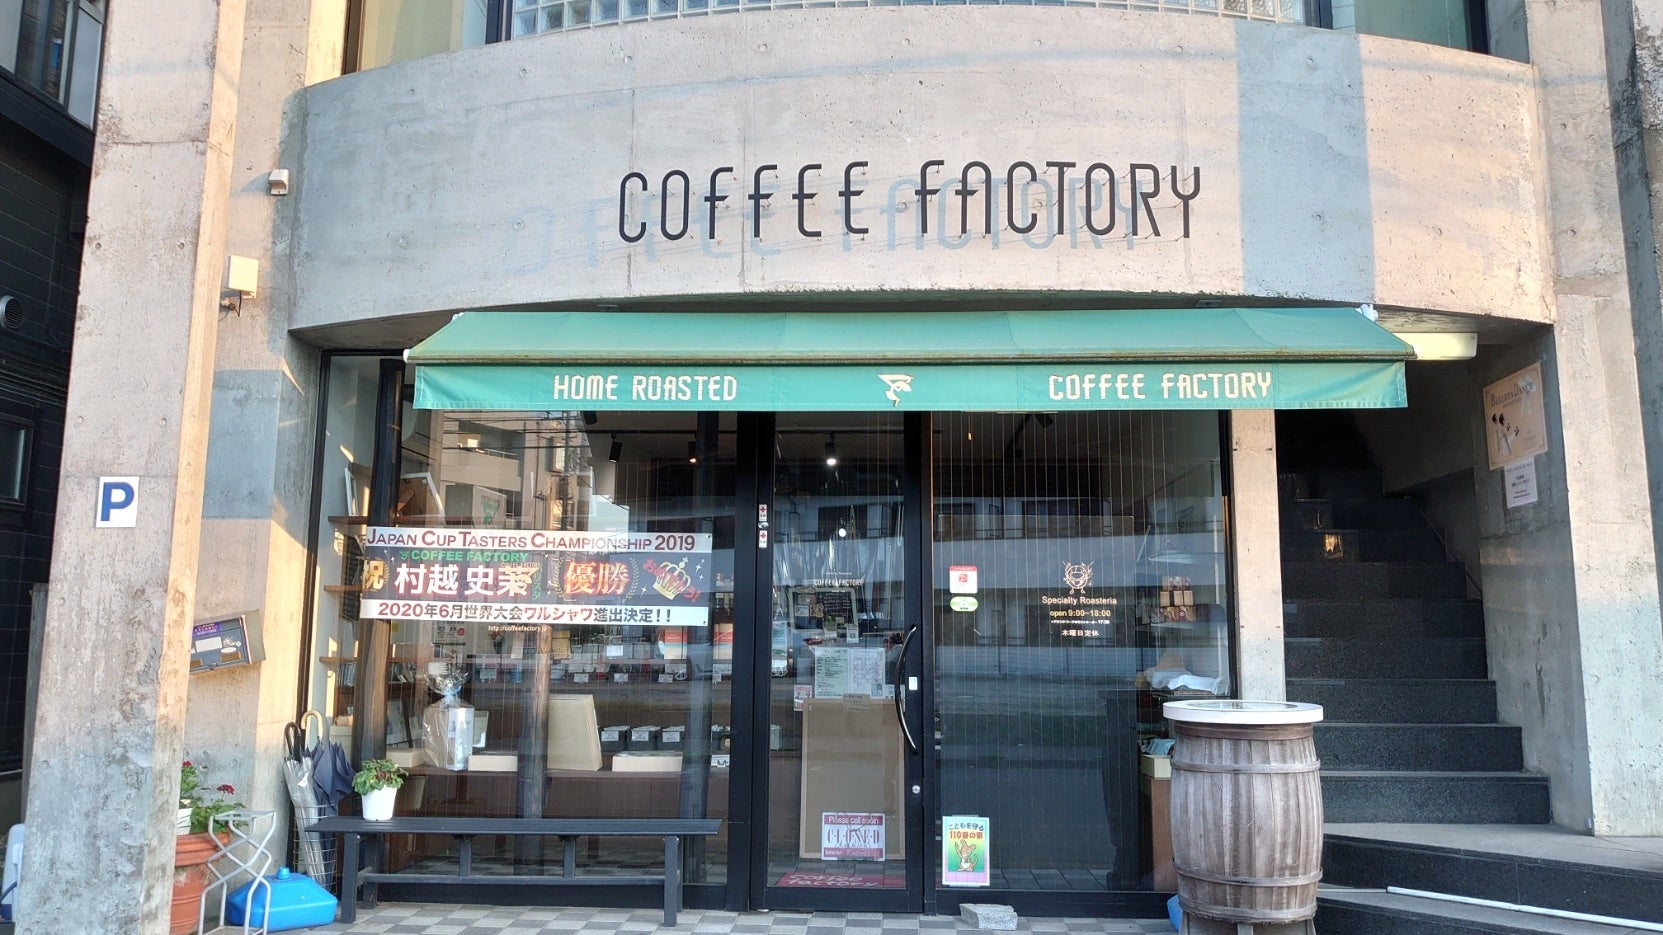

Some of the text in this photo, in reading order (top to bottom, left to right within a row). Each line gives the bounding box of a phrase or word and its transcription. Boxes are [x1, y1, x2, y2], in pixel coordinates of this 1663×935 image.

[619, 159, 1201, 242] COFFEE FACTORY
[553, 371, 1271, 401] HOME ROASTED COFFEE FACTORY
[100, 481, 135, 522] P
[421, 530, 457, 547] CUP
[654, 534, 696, 551] 2019
[411, 550, 529, 562] COFFEE FACTORY
[563, 560, 630, 595] 優勝
[1041, 596, 1117, 606] Specialty Roasteria
